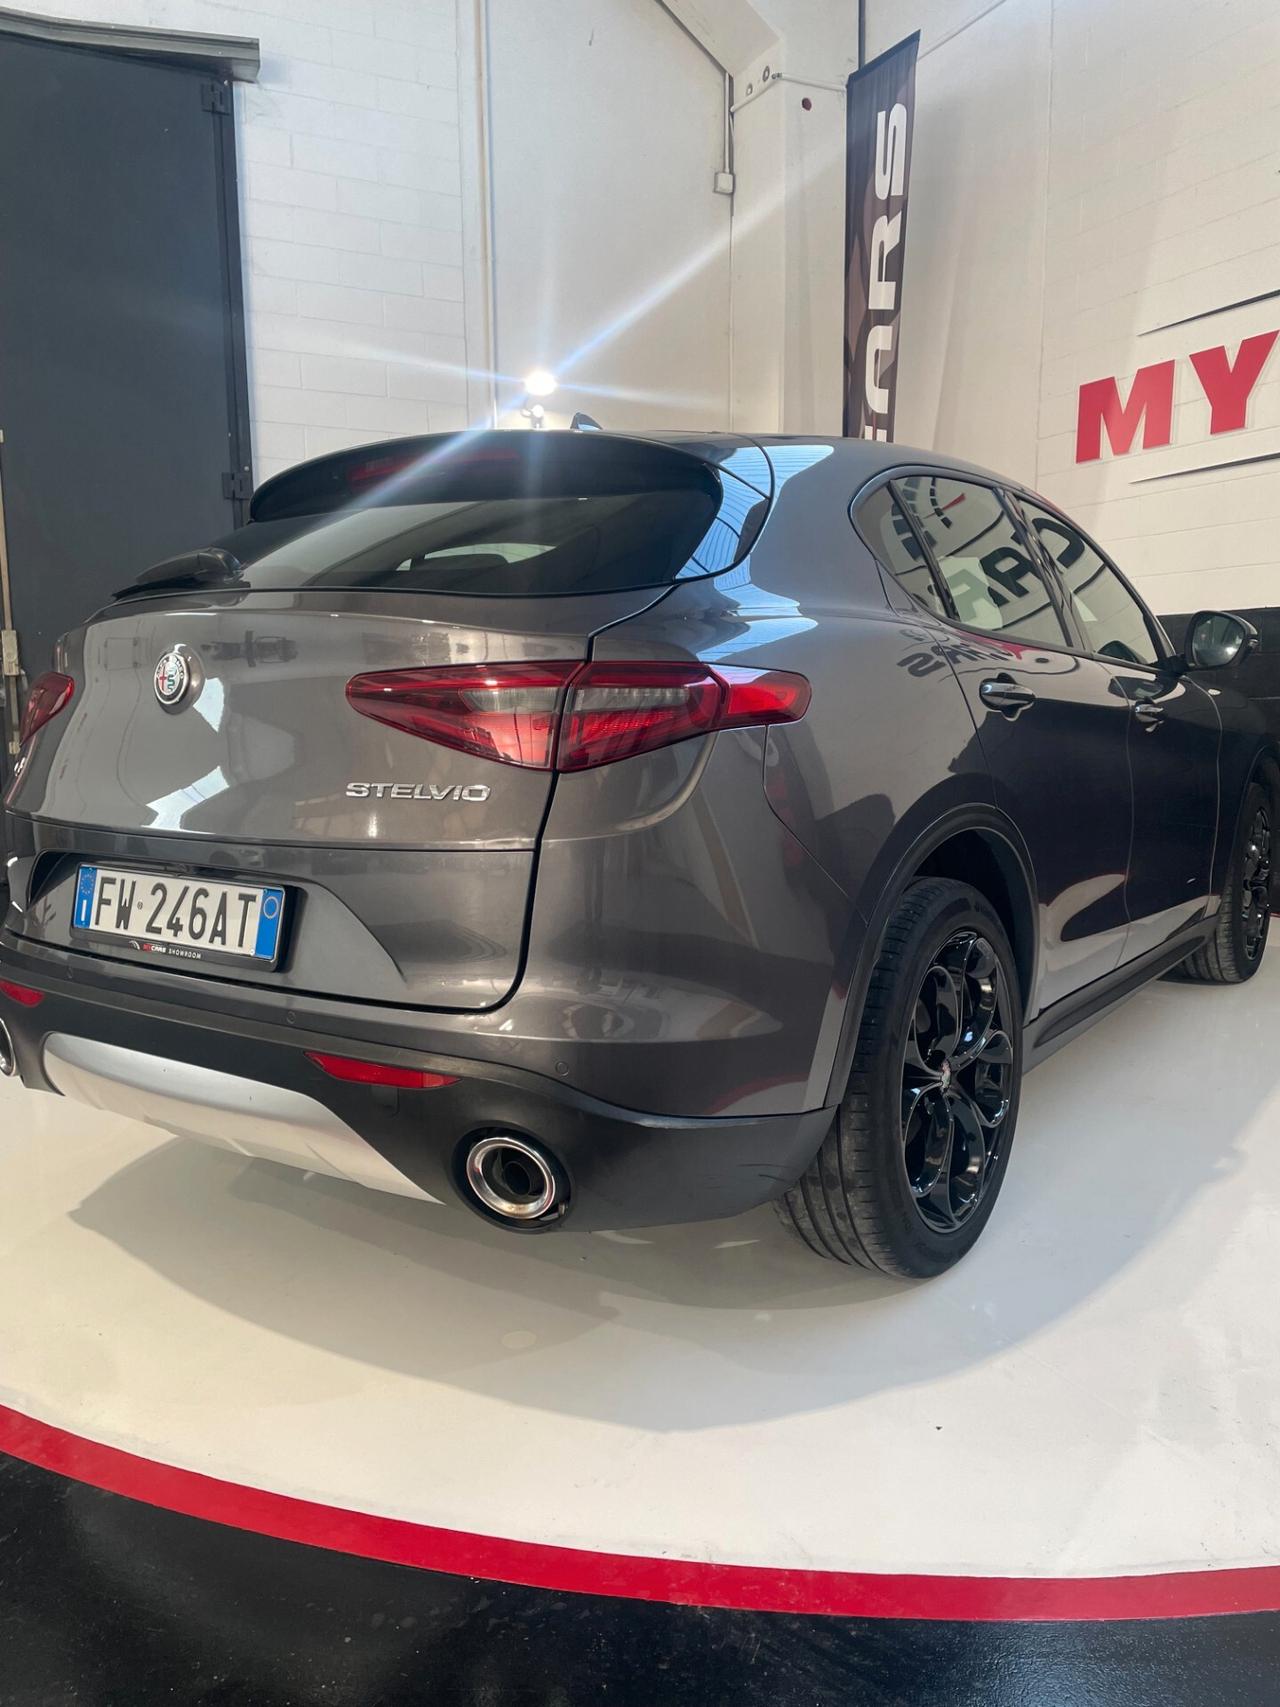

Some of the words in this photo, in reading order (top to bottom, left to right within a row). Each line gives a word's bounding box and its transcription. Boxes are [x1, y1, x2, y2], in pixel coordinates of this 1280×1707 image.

[863, 102, 908, 441] ARS
[1075, 329, 1280, 464] MY
[345, 781, 491, 802] STELVIO
[94, 876, 137, 931] FW
[145, 882, 257, 948] 246AT
